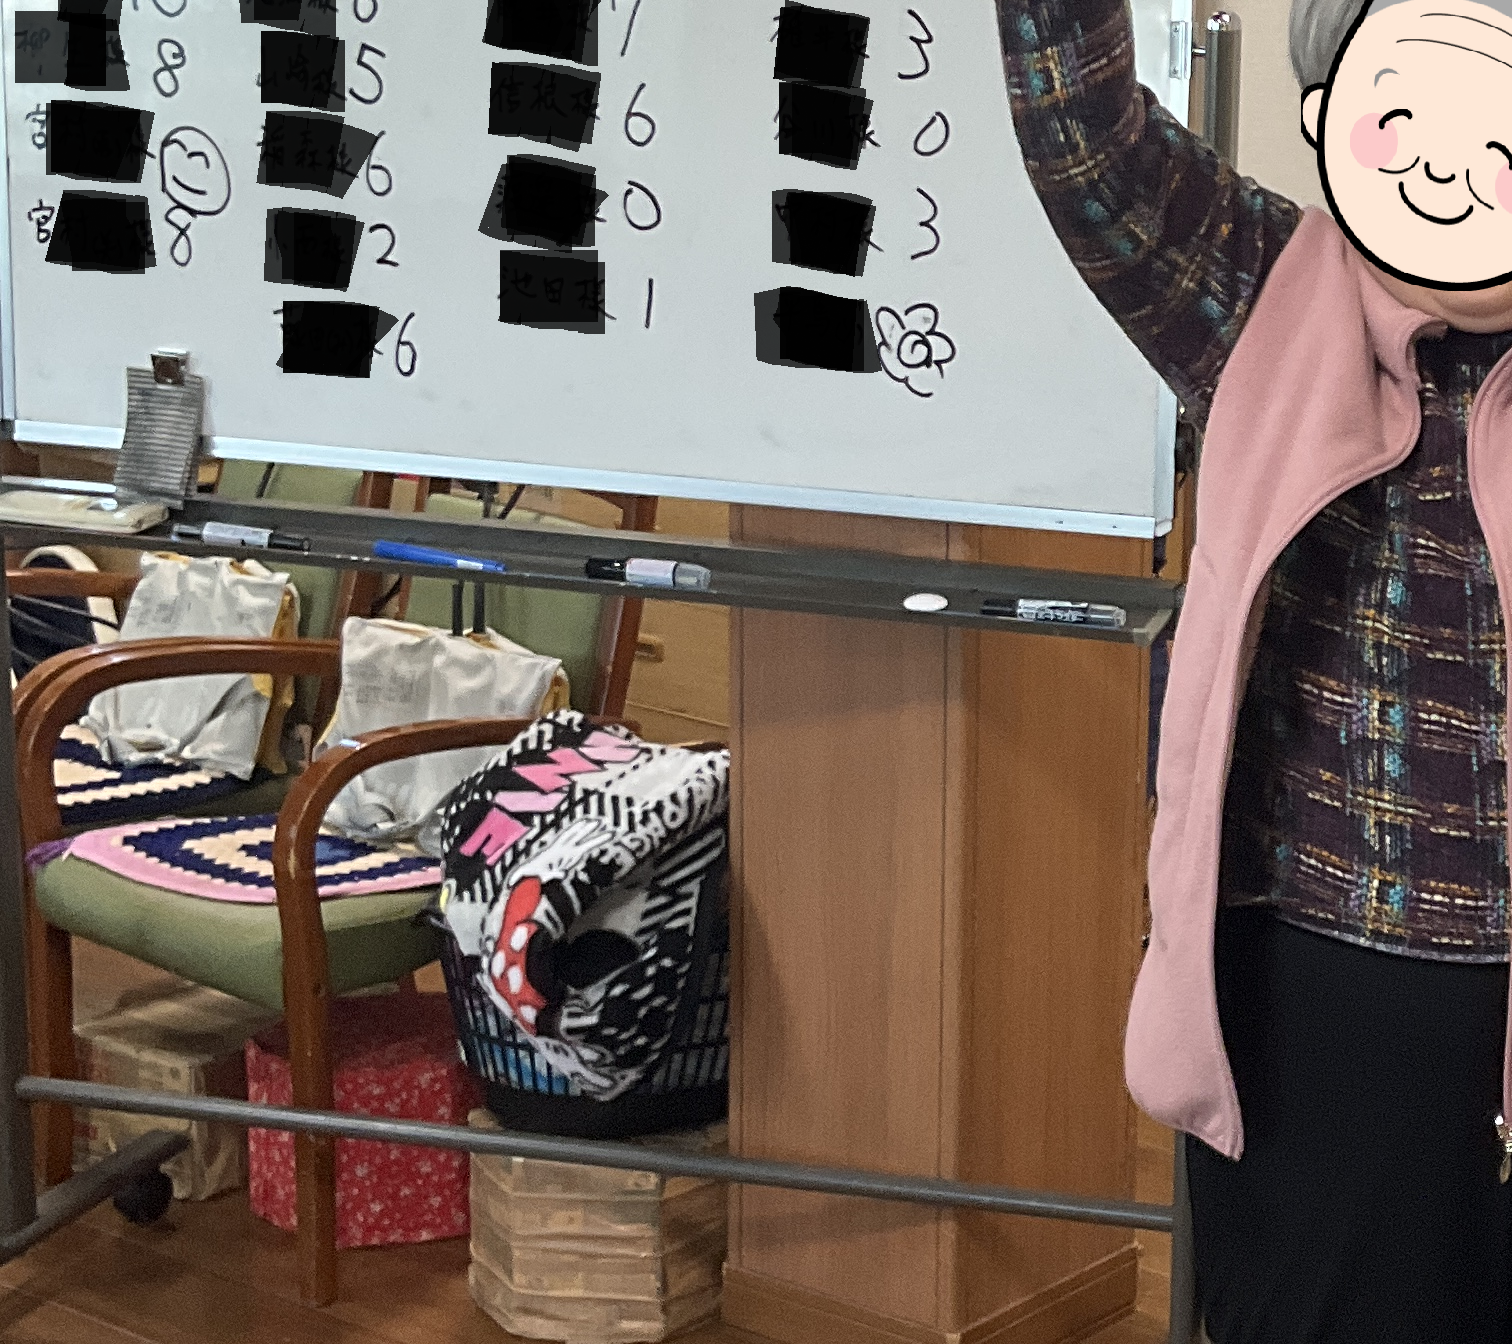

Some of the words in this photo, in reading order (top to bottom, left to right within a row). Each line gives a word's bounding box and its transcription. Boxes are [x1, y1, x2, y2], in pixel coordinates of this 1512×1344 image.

[153, 38, 186, 97] 8
[349, 42, 386, 104] 5
[898, 9, 933, 79] 3
[624, 83, 656, 146] 6
[914, 111, 950, 156] 0
[366, 131, 393, 196] 6
[165, 205, 192, 267] 8
[623, 180, 661, 230] 0
[911, 187, 940, 260] 3
[368, 224, 399, 267] 2
[645, 278, 653, 328] 1
[395, 313, 417, 377] 6
[459, 730, 642, 867] NNIE
